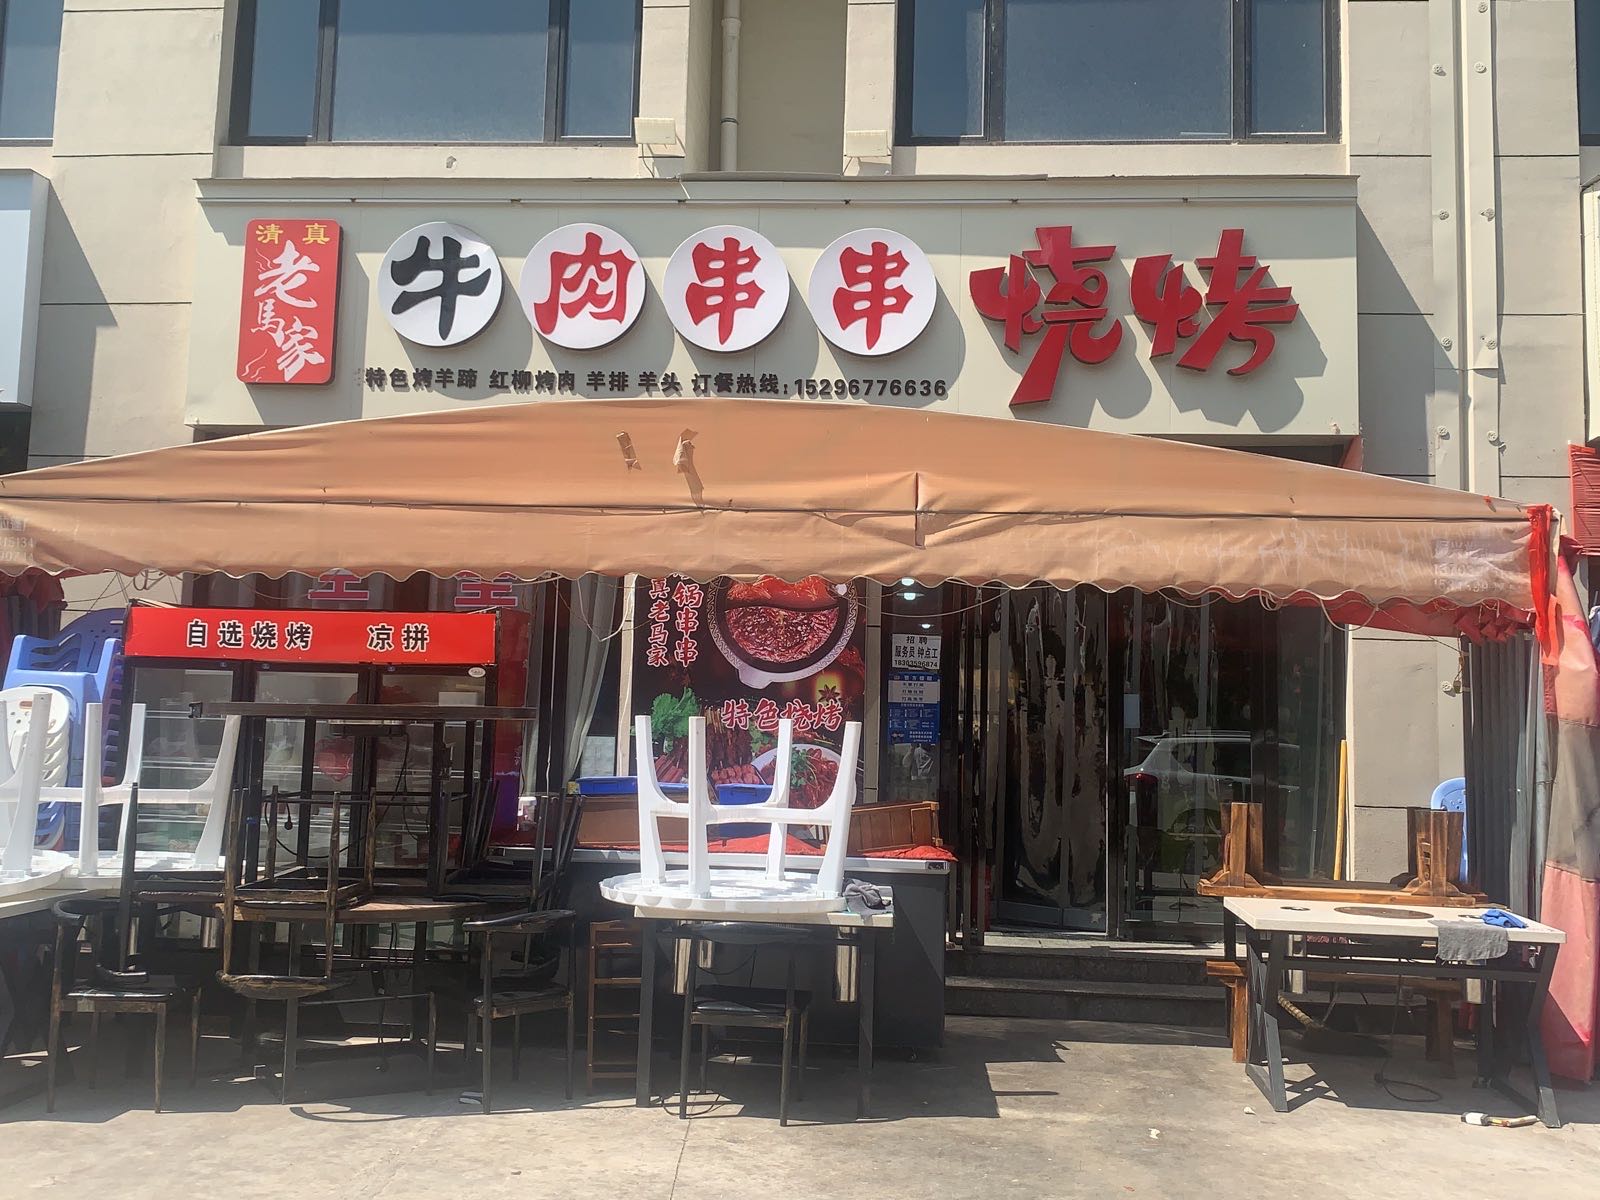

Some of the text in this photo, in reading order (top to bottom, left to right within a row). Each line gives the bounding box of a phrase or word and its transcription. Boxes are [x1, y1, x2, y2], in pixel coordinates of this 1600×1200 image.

[255, 223, 331, 245] 清真
[391, 225, 1300, 406] 牛肉串串 烧烤
[365, 367, 477, 391] 特色烤羊蹄
[489, 369, 576, 392] 红柳烤肉
[587, 371, 630, 392] 羊排
[638, 372, 681, 392] 羊头
[187, 619, 430, 652] 自选烧烤 凉拼
[672, 573, 704, 667] 锅串串
[895, 645, 915, 658] 服务员
[721, 698, 843, 731] 特色烧烤
